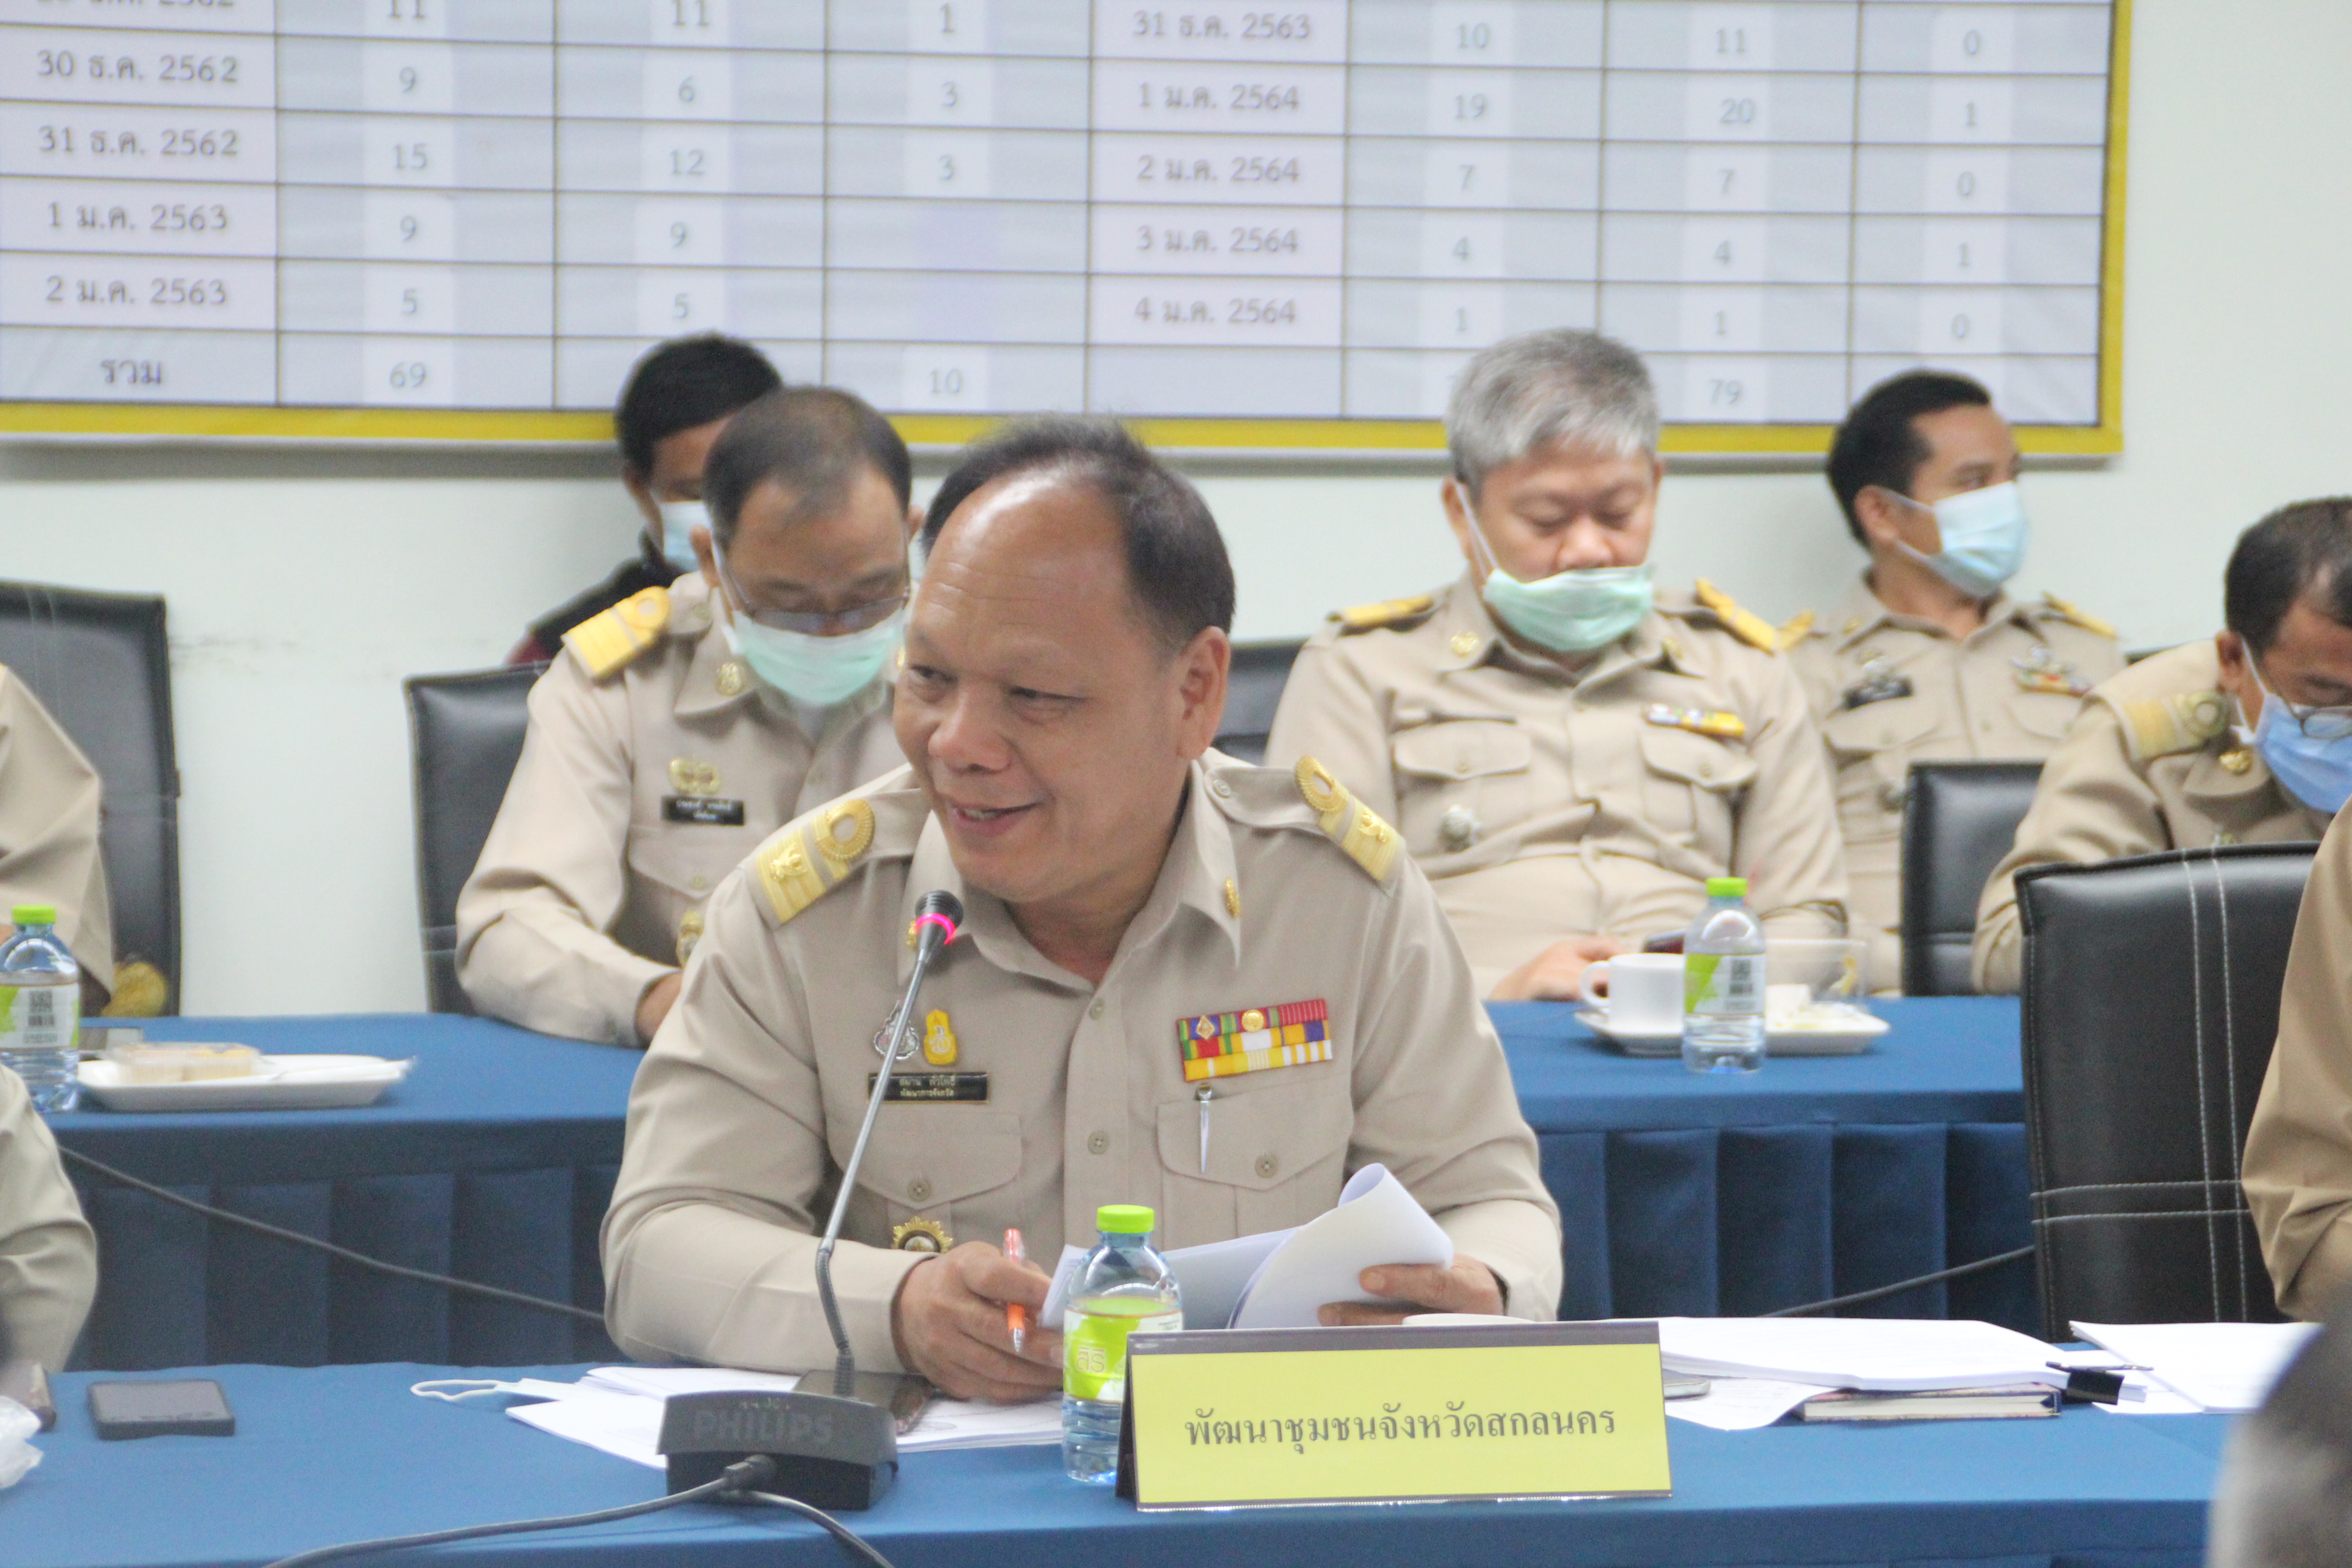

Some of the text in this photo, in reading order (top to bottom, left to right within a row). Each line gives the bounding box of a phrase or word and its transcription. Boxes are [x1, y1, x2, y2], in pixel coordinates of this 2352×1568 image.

[388, 0, 426, 22] 11
[671, 0, 710, 29] 11
[940, 3, 956, 35] 1
[1134, 10, 1312, 41] 31 ธ.ค. 2563
[1458, 23, 1491, 51] 10
[1716, 28, 1747, 56] 11
[1963, 29, 1983, 58] 0
[39, 50, 238, 84] 30 ธ.ค. 2562
[399, 67, 419, 94] 9
[677, 76, 697, 105] 6
[943, 82, 959, 109] 3
[1140, 82, 1300, 112] 1 ม.ค. 2564
[1456, 94, 1489, 120] 19
[1720, 98, 1756, 126] 20
[1965, 102, 1977, 129] 1
[39, 125, 238, 157] 31 ธ.ค. 2562
[393, 142, 429, 172] 15
[671, 149, 705, 178] 12
[940, 155, 956, 183] 3
[1137, 154, 1300, 184] 2 ม.ค. 2564
[1460, 164, 1476, 191] 7
[1720, 169, 1735, 195] 7
[1957, 172, 1976, 199] 0
[49, 201, 229, 233] 1 ม.ค. 2563
[400, 215, 419, 243] 9
[671, 223, 688, 248] 9
[1138, 225, 1299, 254] 3 ม.ค. 2564
[1453, 237, 1471, 262] 4
[1715, 241, 1732, 265] 4
[1958, 242, 1970, 270] 1
[46, 275, 228, 306] 2 ม.ค. 2563
[402, 288, 419, 317] 5
[674, 293, 691, 321] 5
[1135, 297, 1297, 325] 4 ม.ค. 2564
[1456, 307, 1468, 334] 1
[1715, 311, 1728, 337] 1
[1951, 314, 1970, 342] 0
[100, 360, 163, 386] รวม
[389, 363, 428, 390] 69
[930, 368, 965, 396] 10
[1712, 379, 1743, 405] 79
[691, 1409, 833, 1443] PHILIPS
[1185, 1400, 1615, 1455] พัฒนาชุมชนจังหวัดสกลนคร
